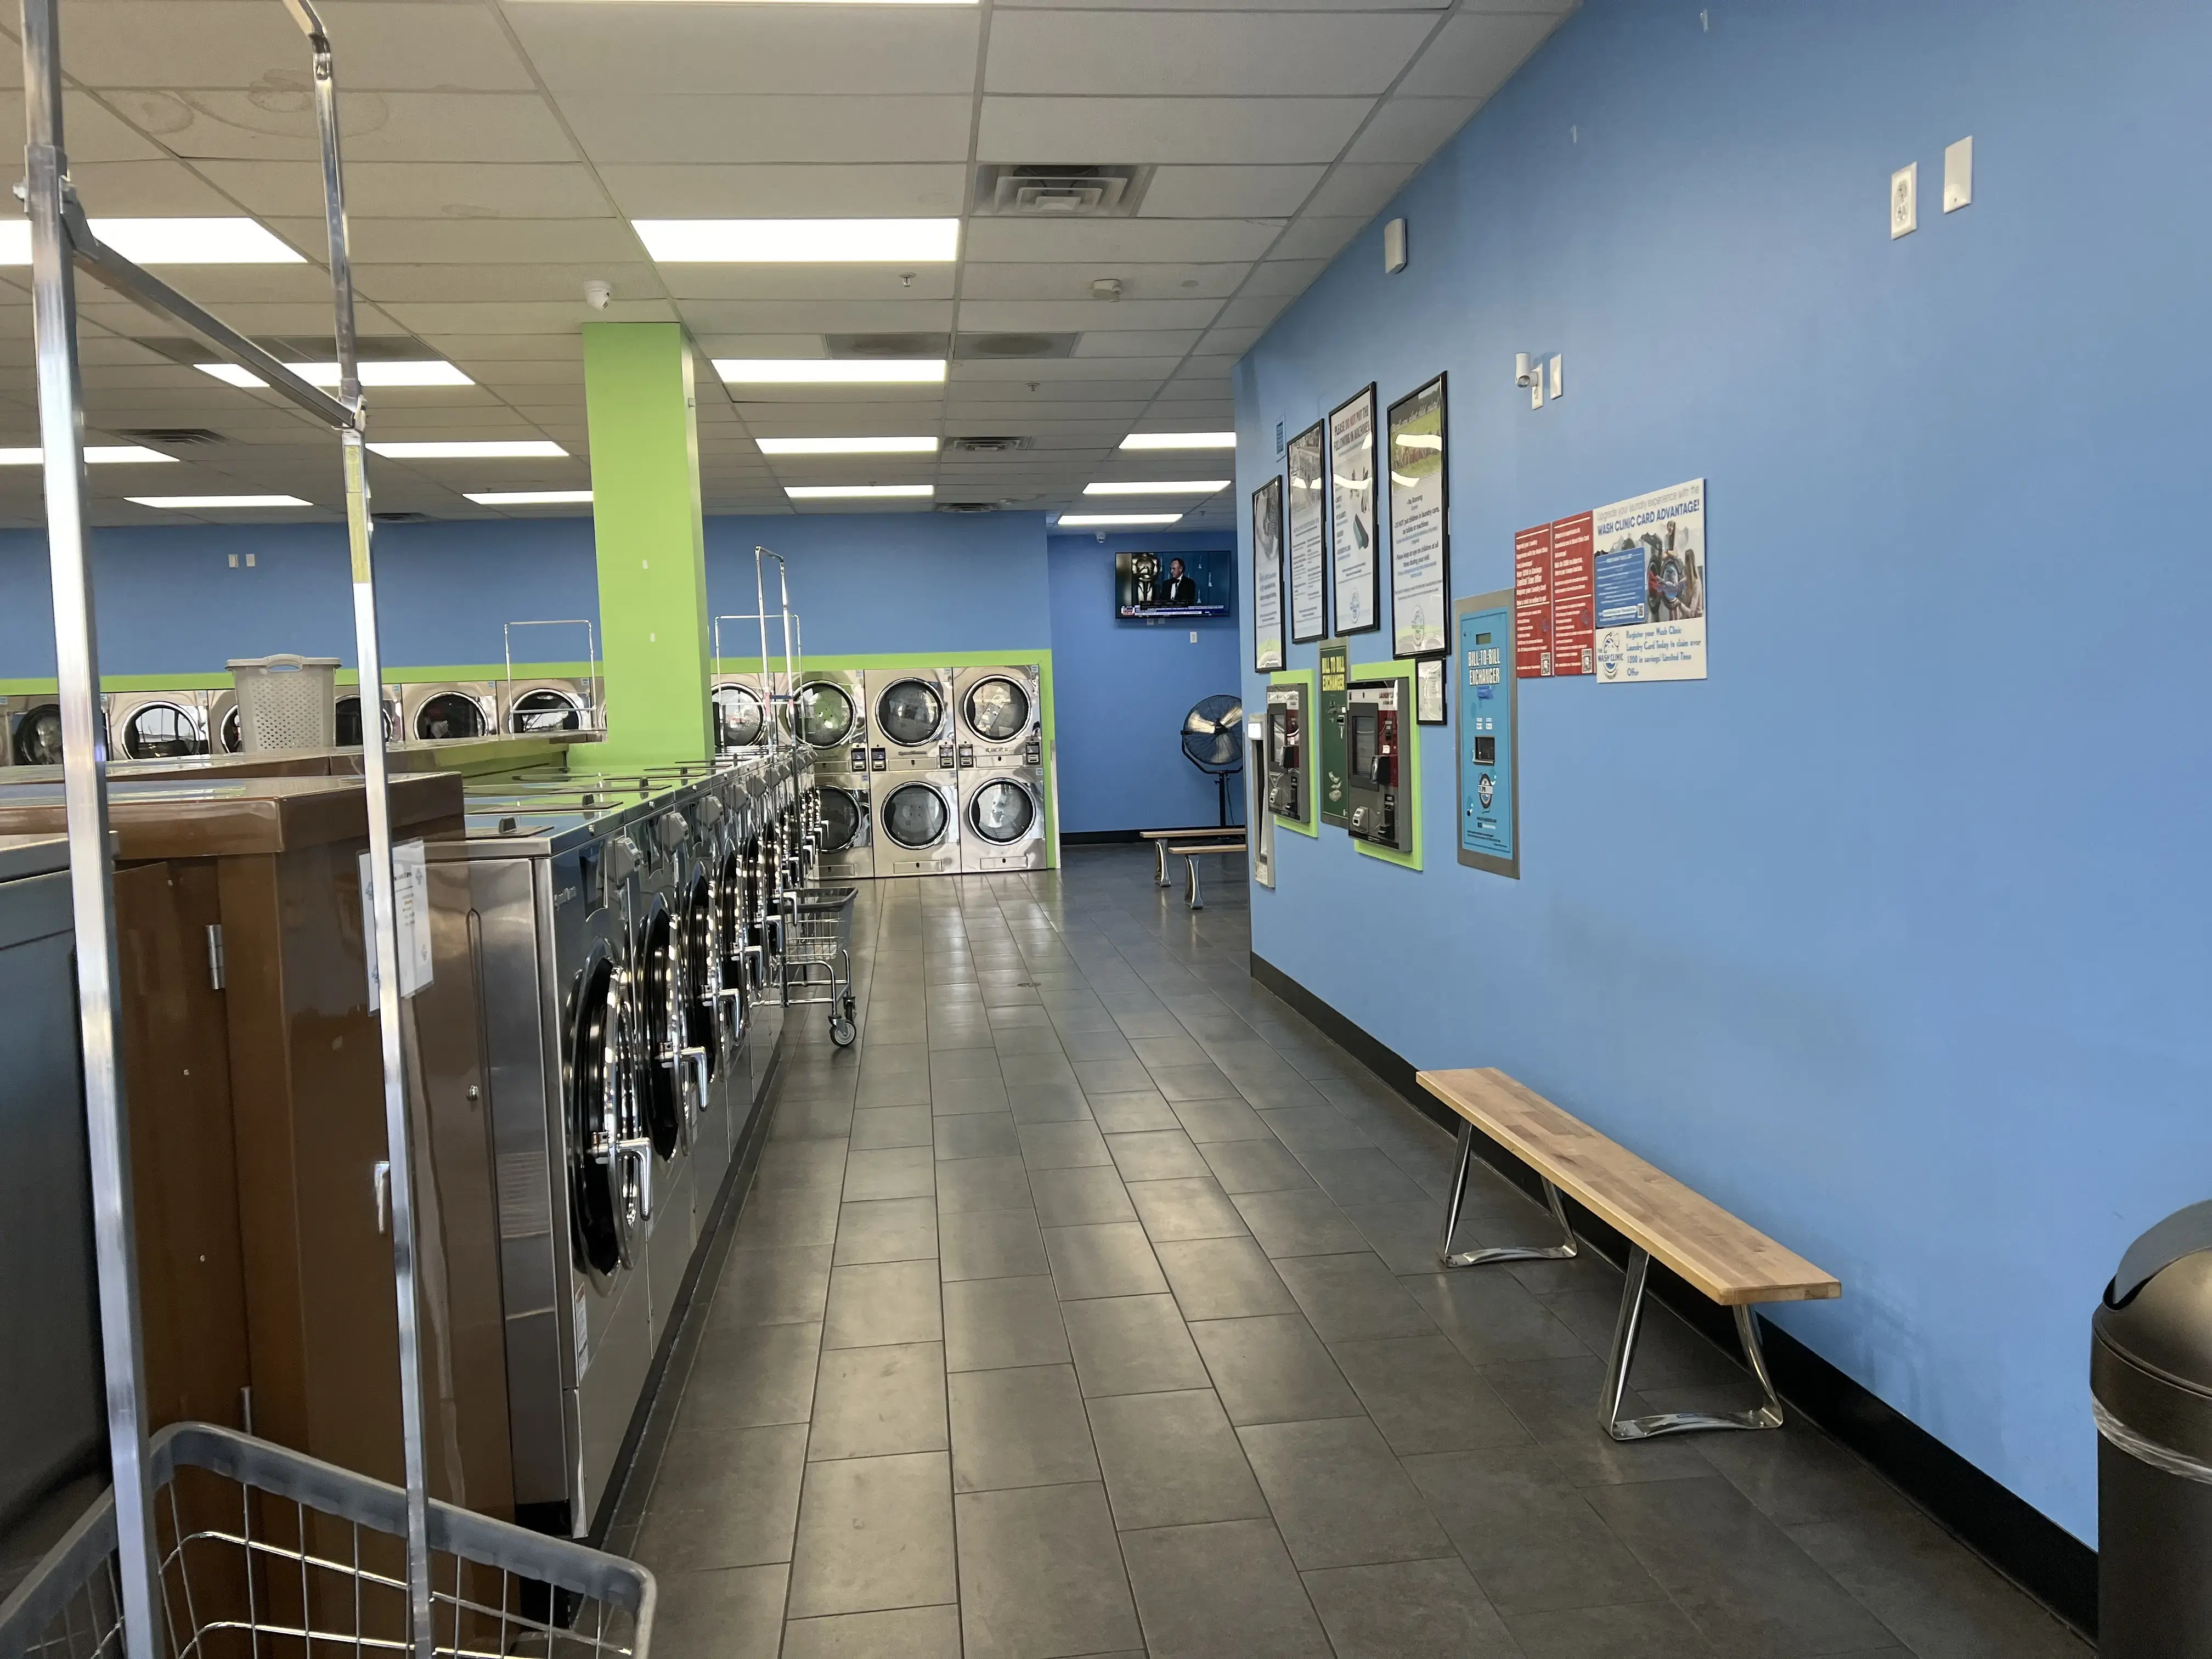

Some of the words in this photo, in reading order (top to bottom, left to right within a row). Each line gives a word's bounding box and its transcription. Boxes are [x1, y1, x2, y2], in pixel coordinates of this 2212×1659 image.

[1597, 509, 1617, 521] Upgrade
[1618, 506, 1628, 517] your
[1629, 500, 1646, 512] laundry
[1648, 494, 1677, 507] experience
[1678, 487, 1689, 499] with
[1597, 523, 1614, 536] WASH
[1615, 516, 1635, 532] CLINIC
[1637, 511, 1655, 526] CARD
[1656, 499, 1700, 521] ADVANTAGE!
[1626, 630, 1643, 640] Register
[1656, 627, 1667, 635] Wash
[1669, 625, 1681, 634] Clinic
[1626, 642, 1643, 652] Laundry
[1644, 641, 1655, 650] Card
[1656, 640, 1668, 650] Today
[1677, 638, 1689, 647] claim
[1322, 657, 1330, 674] BILL
[1330, 656, 1336, 673] TO
[1336, 655, 1345, 673] BILL
[1468, 647, 1500, 667] BILL-TO-BILL
[1610, 653, 1624, 661] CLINIC
[1627, 654, 1638, 663] $200
[1662, 652, 1679, 661] Limited
[1680, 651, 1691, 660] Time
[1469, 668, 1500, 685] EXCHANGER
[1627, 668, 1639, 676] Offer
